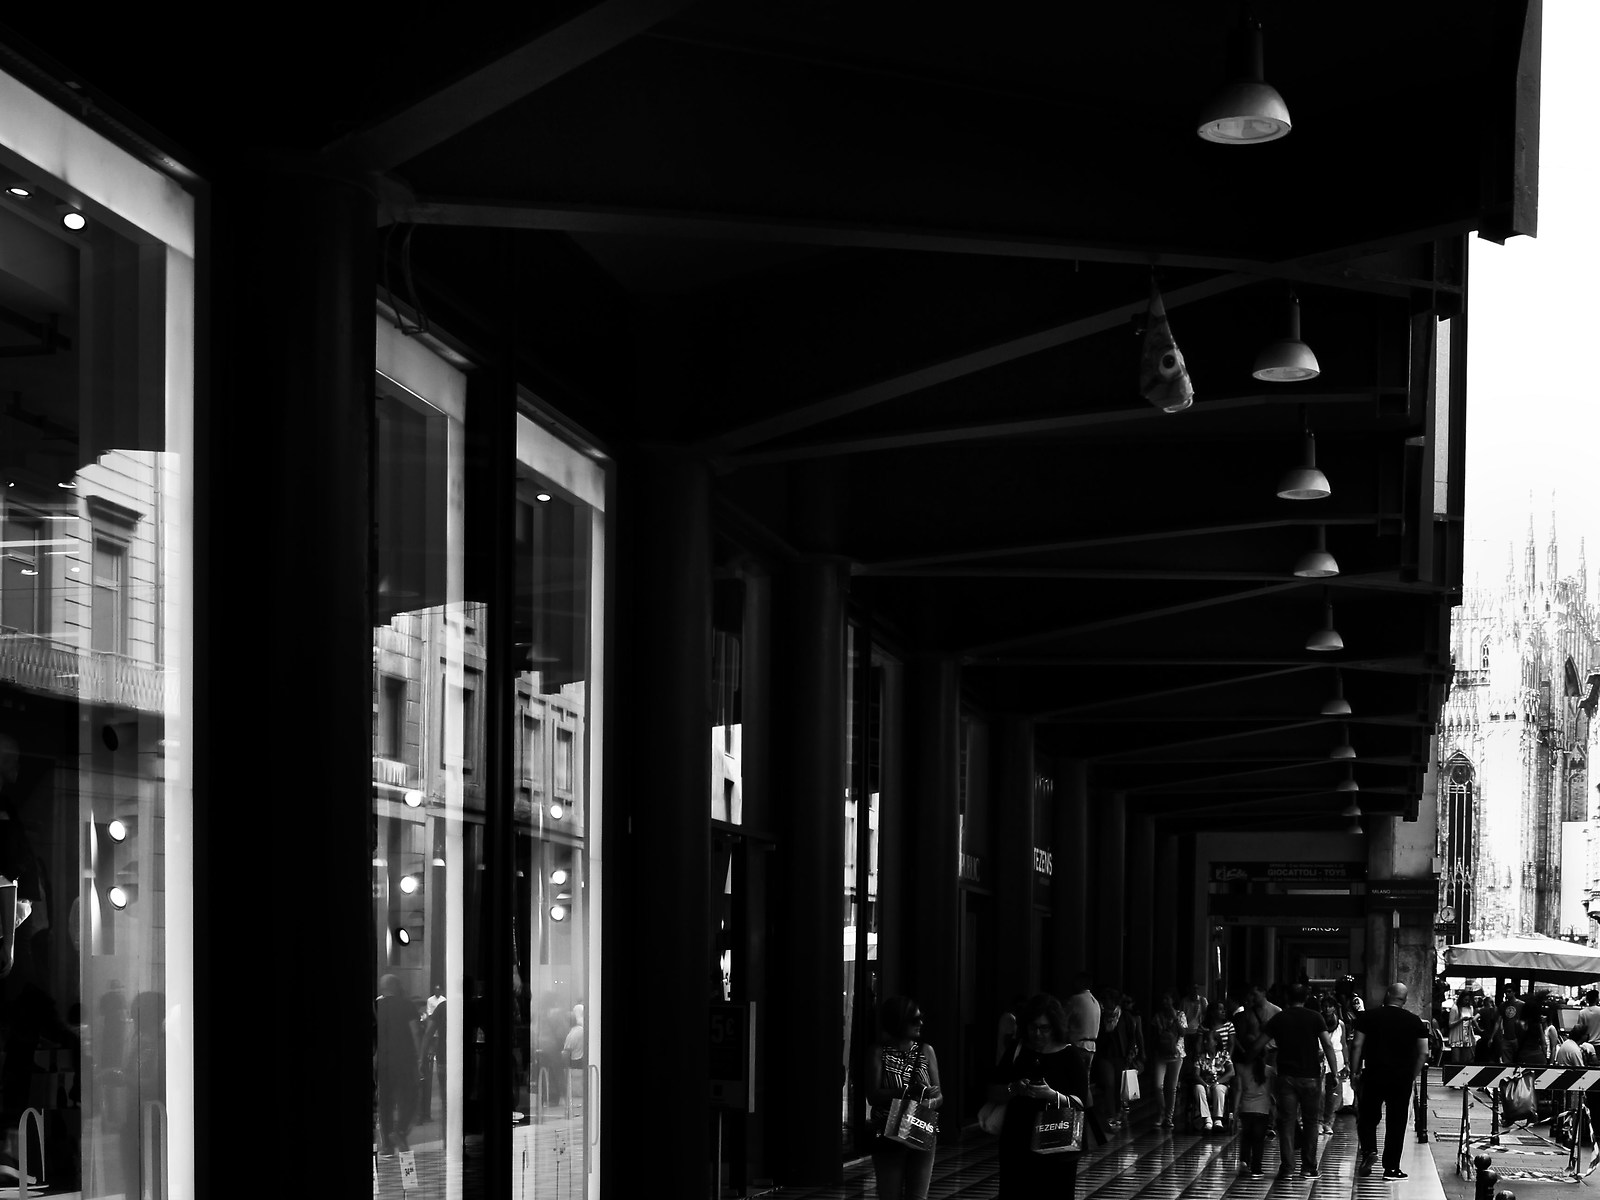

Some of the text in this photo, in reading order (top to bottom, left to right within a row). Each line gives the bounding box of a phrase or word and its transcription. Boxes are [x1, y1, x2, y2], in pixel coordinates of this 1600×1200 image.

[1033, 847, 1053, 876] TEZENIS
[906, 1114, 934, 1133] TEZENIS
[1035, 1120, 1069, 1133] TEZENIS
